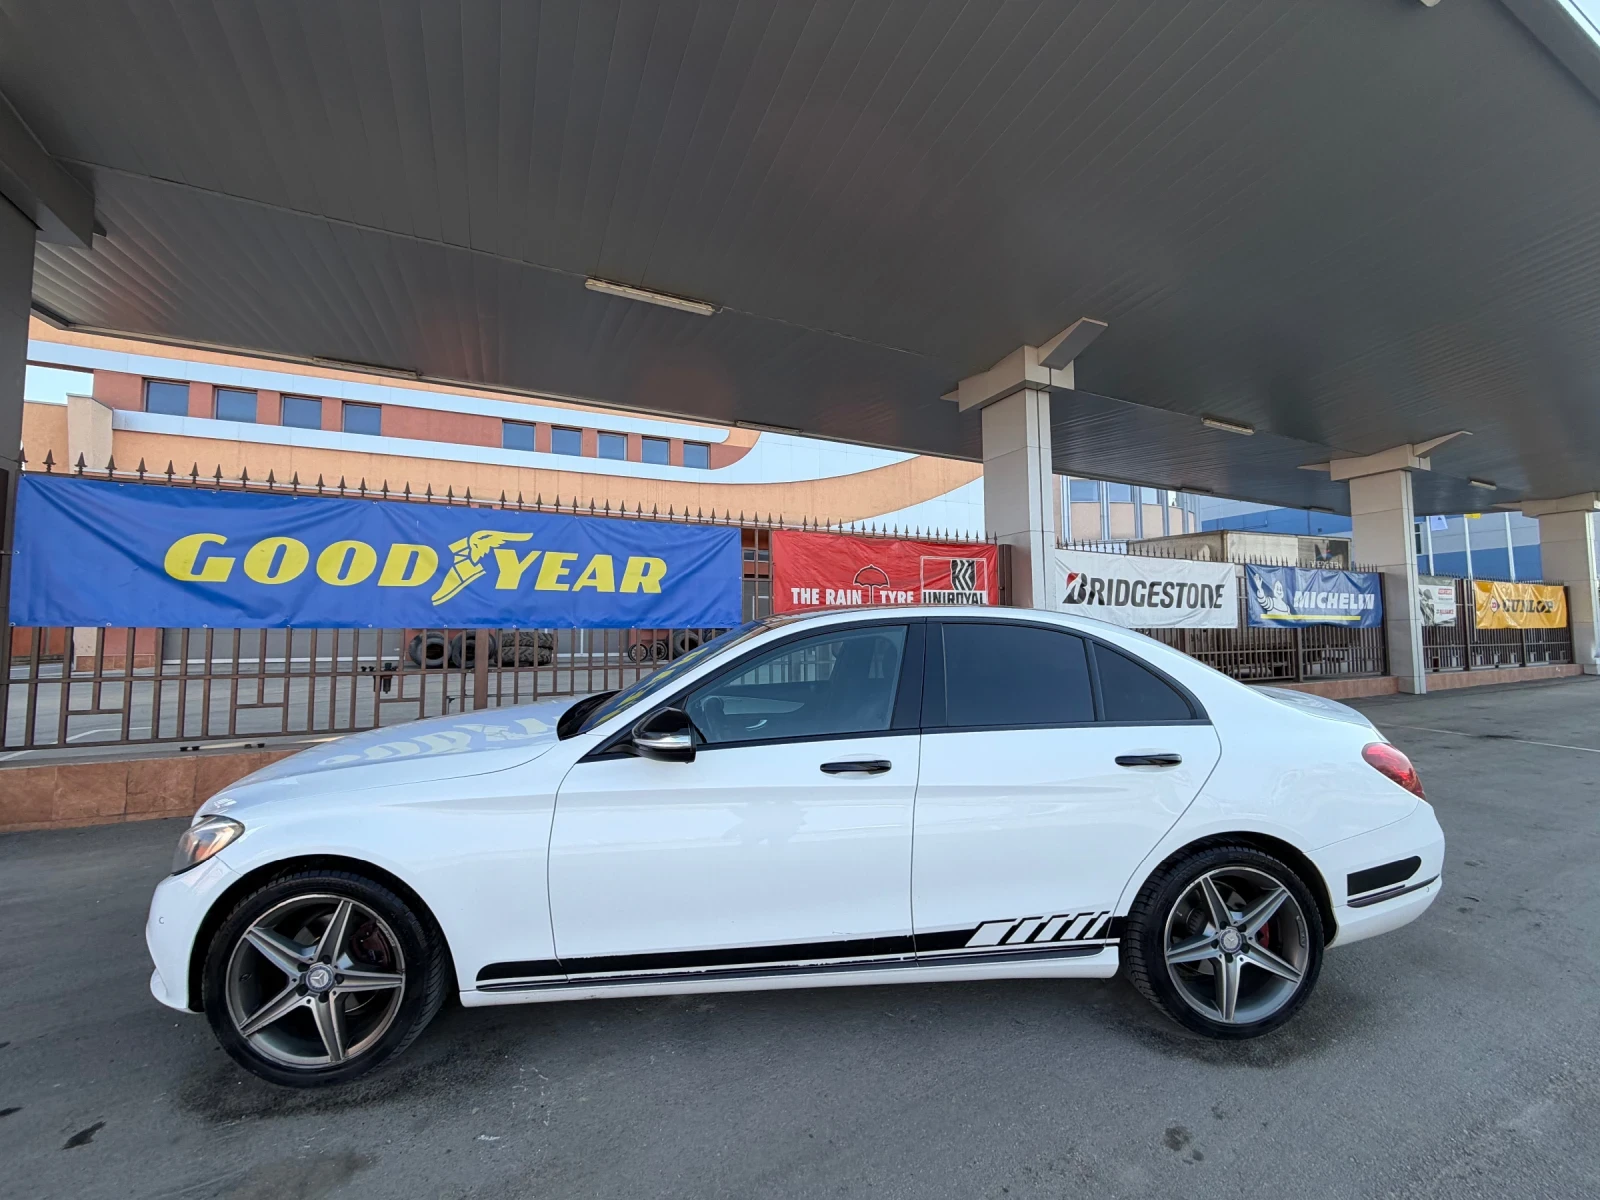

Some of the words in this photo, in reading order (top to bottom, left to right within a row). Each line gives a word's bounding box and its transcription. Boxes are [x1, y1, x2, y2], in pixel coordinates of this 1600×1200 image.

[791, 587, 820, 604] THE
[826, 588, 862, 605] RAIN
[1062, 572, 1225, 609] BRIDGESTONE
[1293, 590, 1375, 610] MICHELIN
